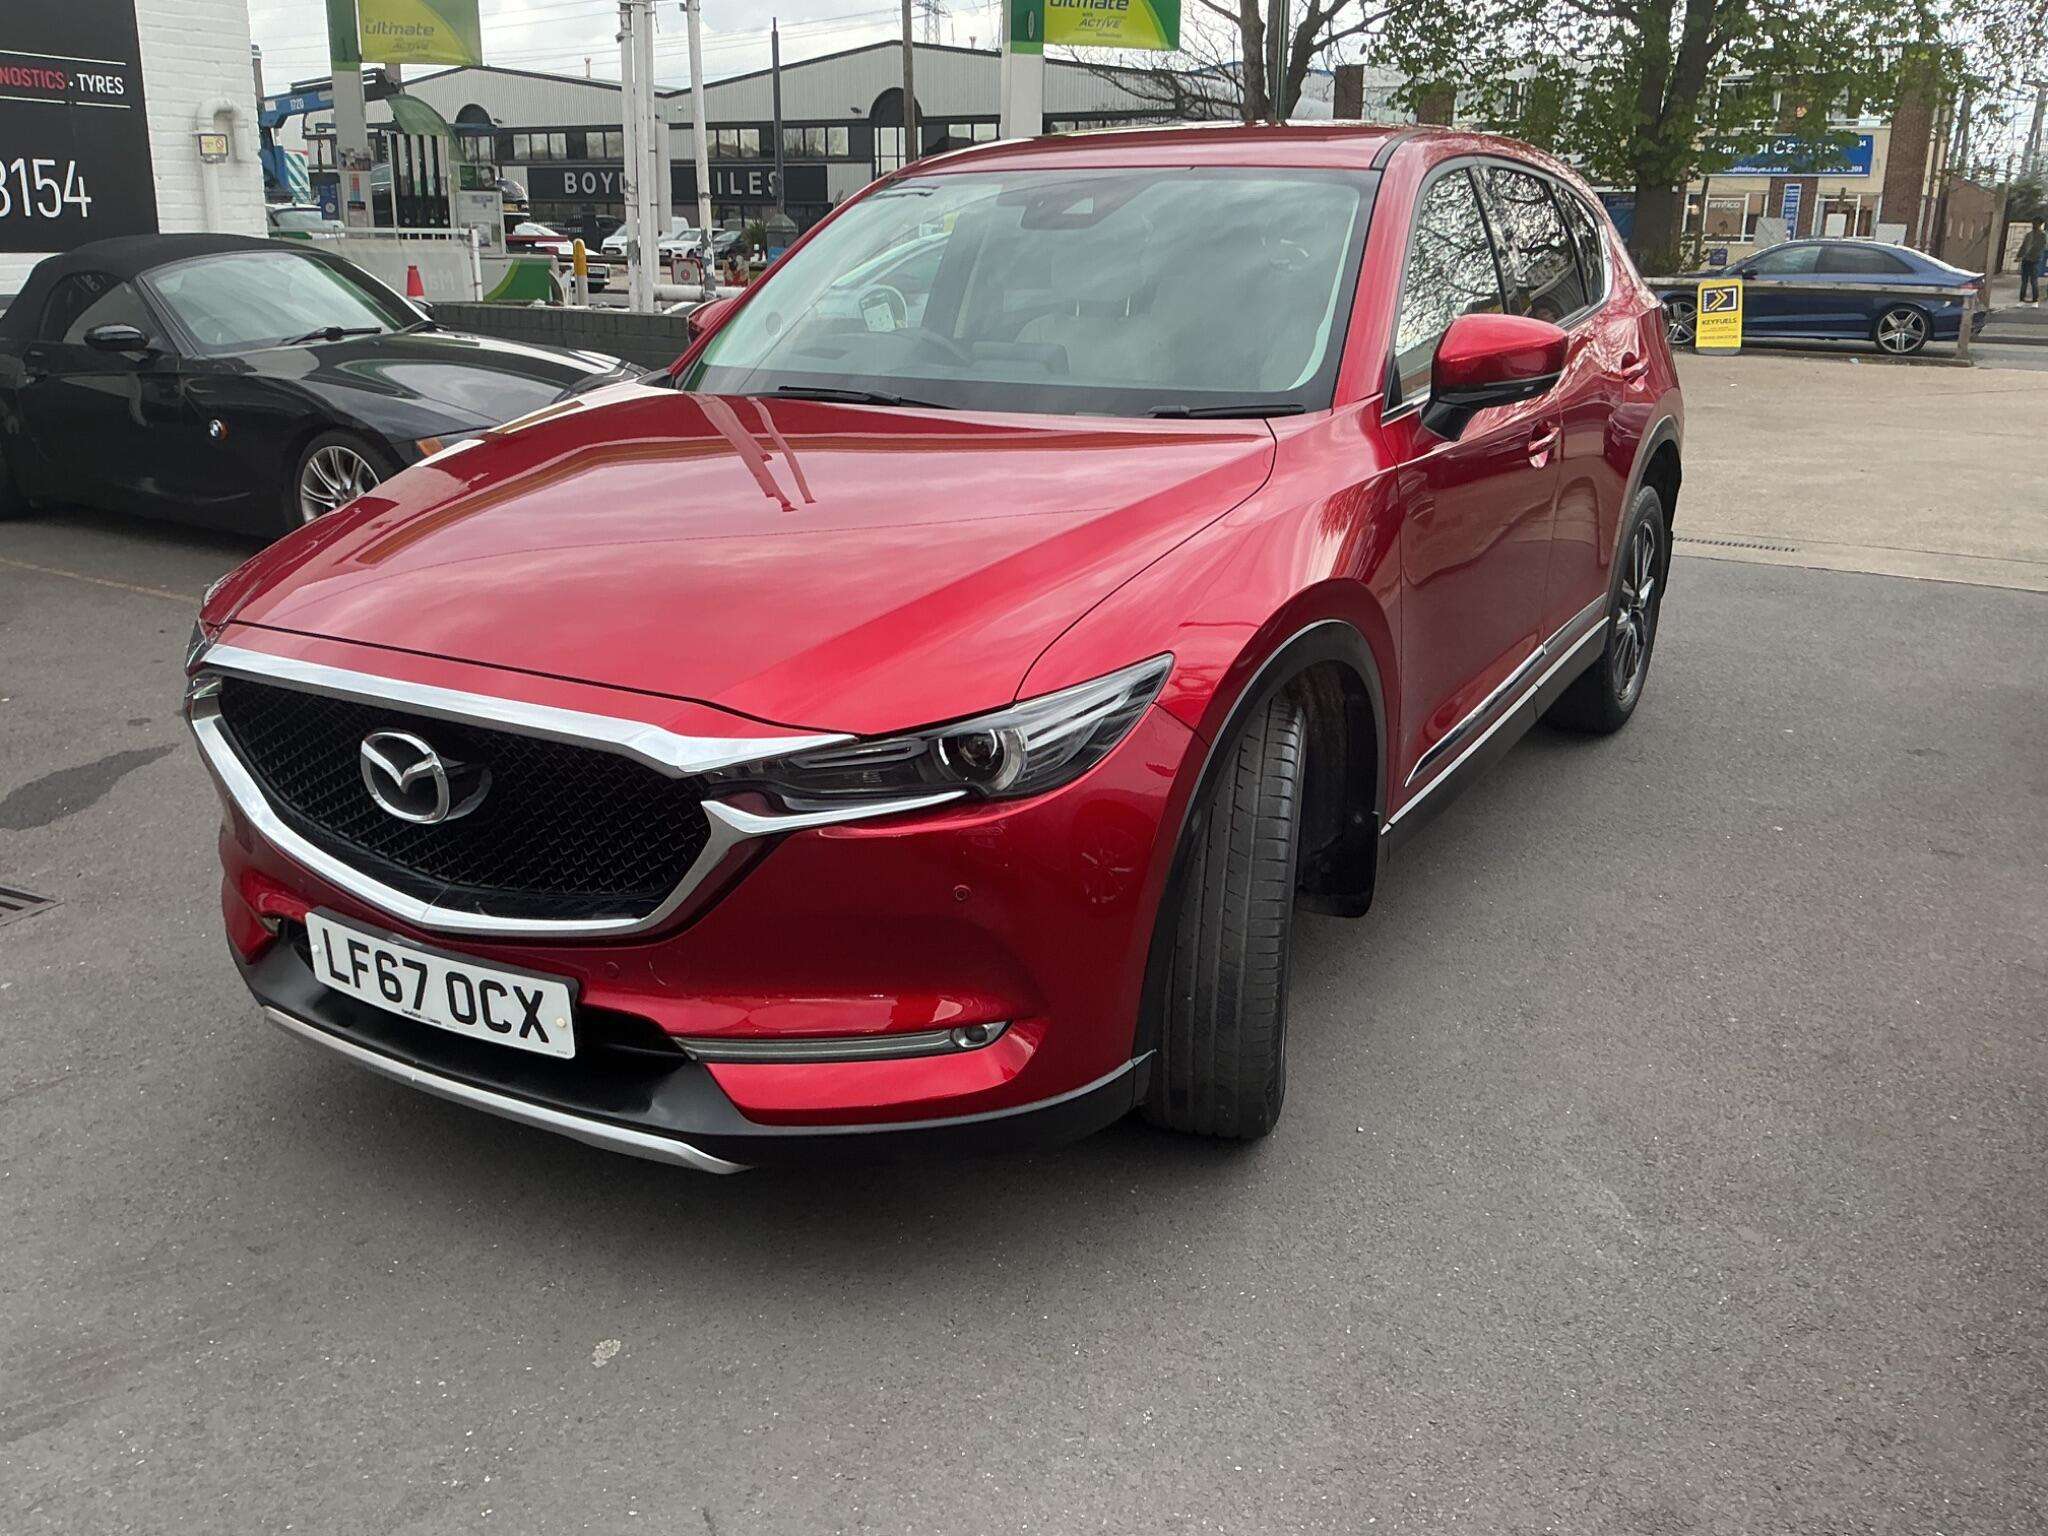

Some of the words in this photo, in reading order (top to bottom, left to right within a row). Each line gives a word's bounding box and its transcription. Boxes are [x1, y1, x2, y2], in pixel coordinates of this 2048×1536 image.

[365, 21, 435, 36] ultimate
[1080, 18, 1121, 29] ACTIVE
[76, 73, 125, 95] TYRES
[322, 928, 428, 1010] LF67
[445, 971, 550, 1043] OCX
